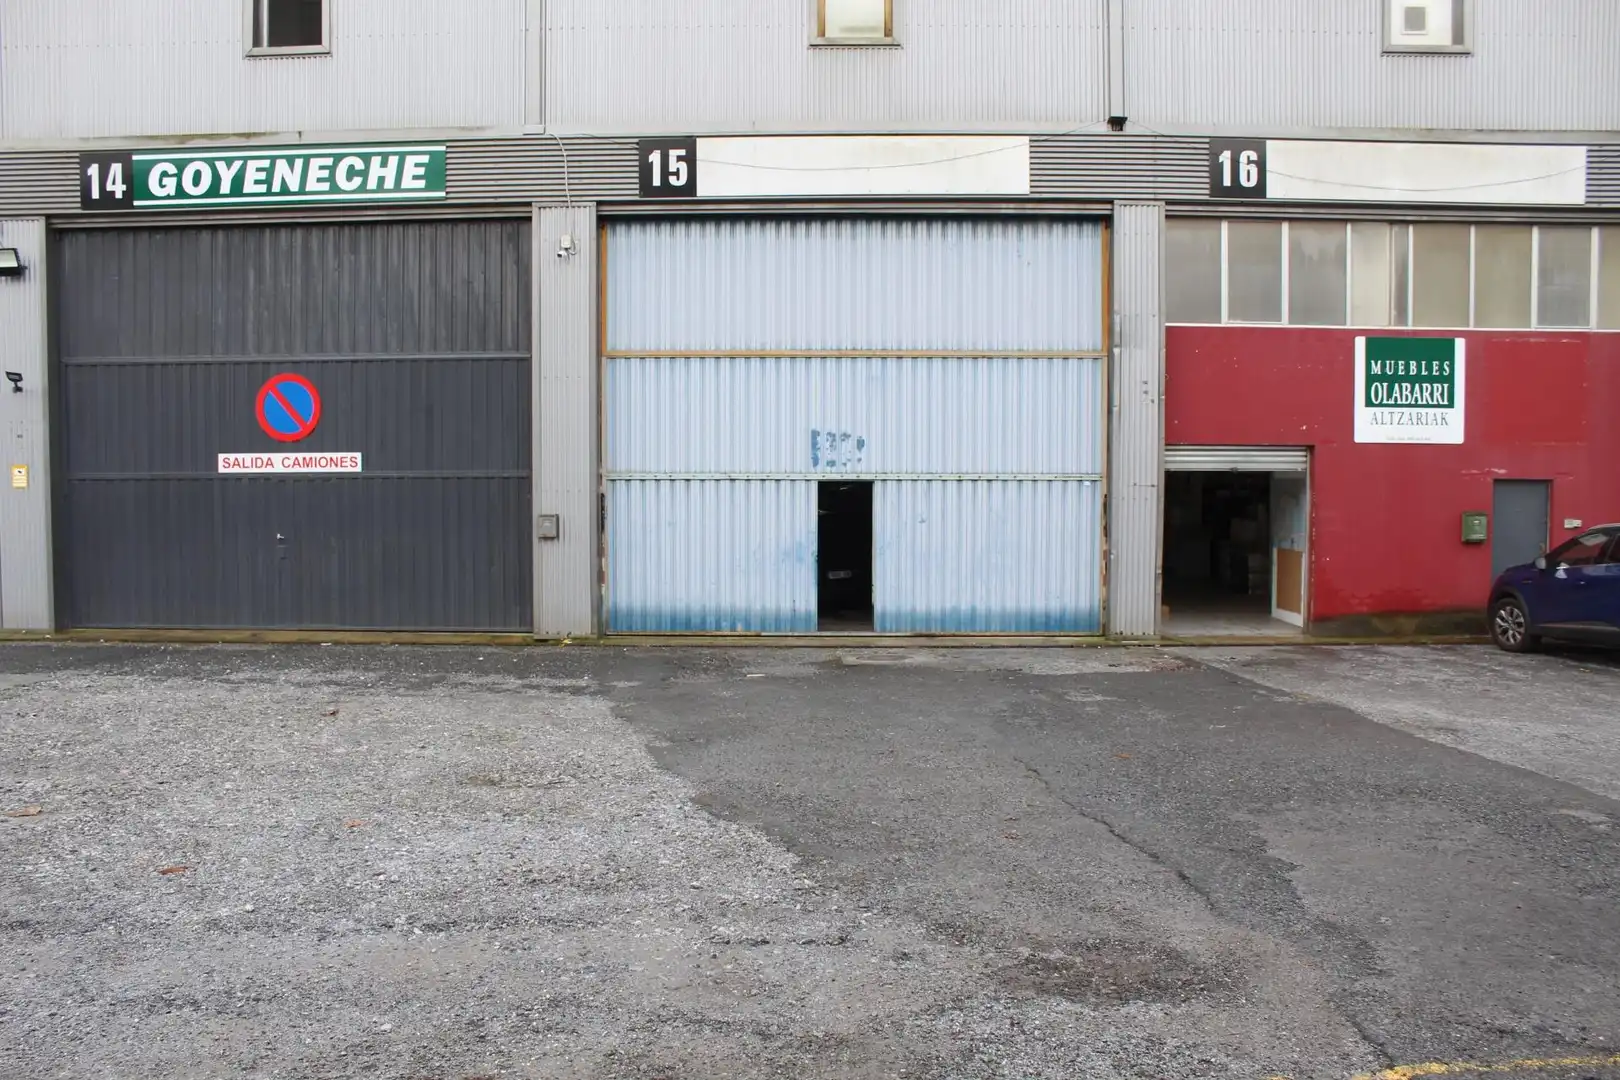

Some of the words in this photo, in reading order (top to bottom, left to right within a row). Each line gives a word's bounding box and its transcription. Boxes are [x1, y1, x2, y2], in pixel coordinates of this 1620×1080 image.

[87, 162, 127, 199] 14
[148, 154, 431, 197] GOYENECHE
[648, 148, 688, 187] 15
[1218, 149, 1259, 188] 16
[1370, 359, 1450, 376] MUEBLES
[1370, 381, 1449, 405] OLABARRI
[1369, 411, 1449, 426] ALTZARIAK
[222, 456, 275, 469] SALIDA
[281, 456, 359, 469] CAMIONES
